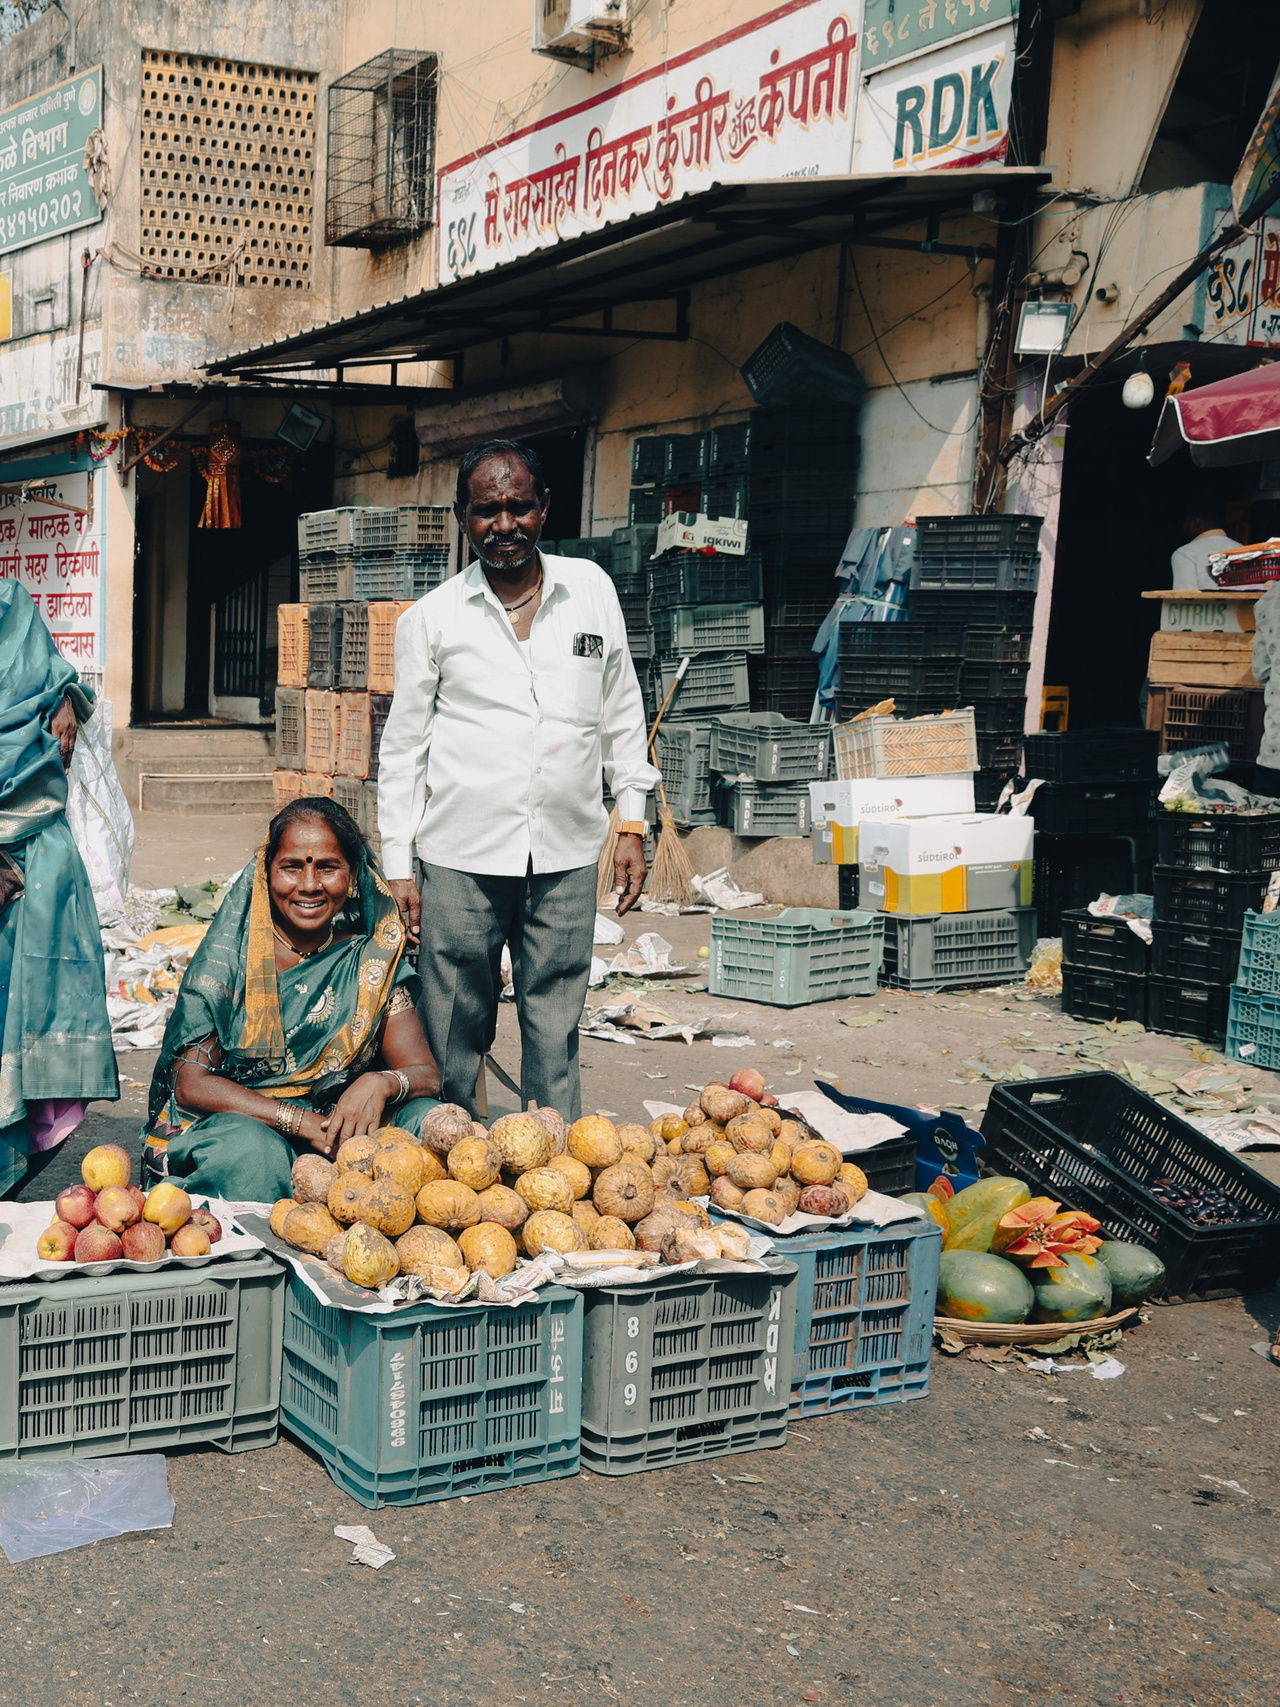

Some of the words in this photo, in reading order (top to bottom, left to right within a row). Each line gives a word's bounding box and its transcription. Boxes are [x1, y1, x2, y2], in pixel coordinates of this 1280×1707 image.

[17, 107, 39, 130] बाजार
[63, 85, 77, 111] पुणे
[584, 127, 652, 219] दिनकर
[758, 16, 858, 138] कंपनी
[893, 58, 1003, 166] RDK
[21, 121, 69, 165] विभाग
[8, 175, 44, 205] निवारण
[28, 513, 70, 540] मालक
[24, 554, 49, 584] सदर
[55, 541, 100, 578] ठिकाणी
[1168, 603, 1228, 626] CITRUS
